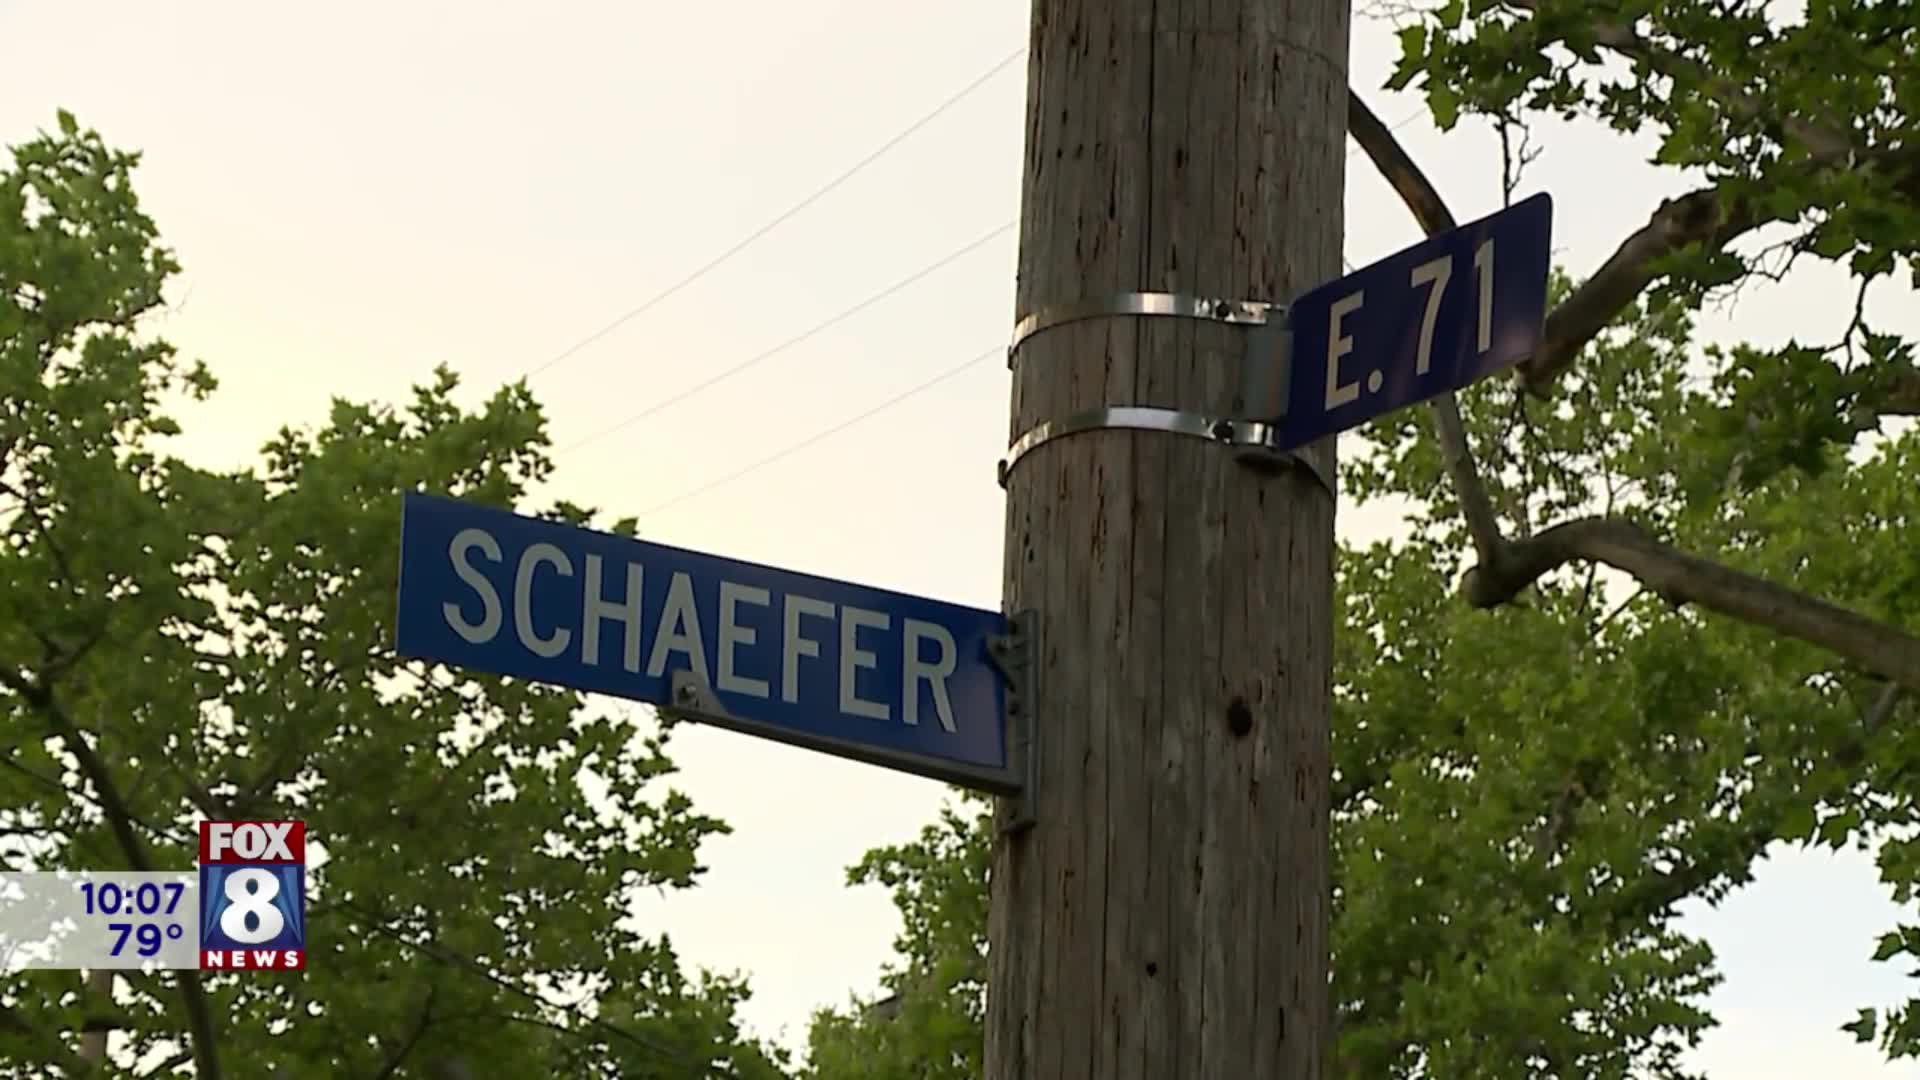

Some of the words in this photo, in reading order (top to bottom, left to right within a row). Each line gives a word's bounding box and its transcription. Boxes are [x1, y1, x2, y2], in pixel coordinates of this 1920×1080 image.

[1325, 290, 1384, 412] E.
[1410, 237, 1495, 377] 71
[443, 528, 958, 734] SCHAEFER
